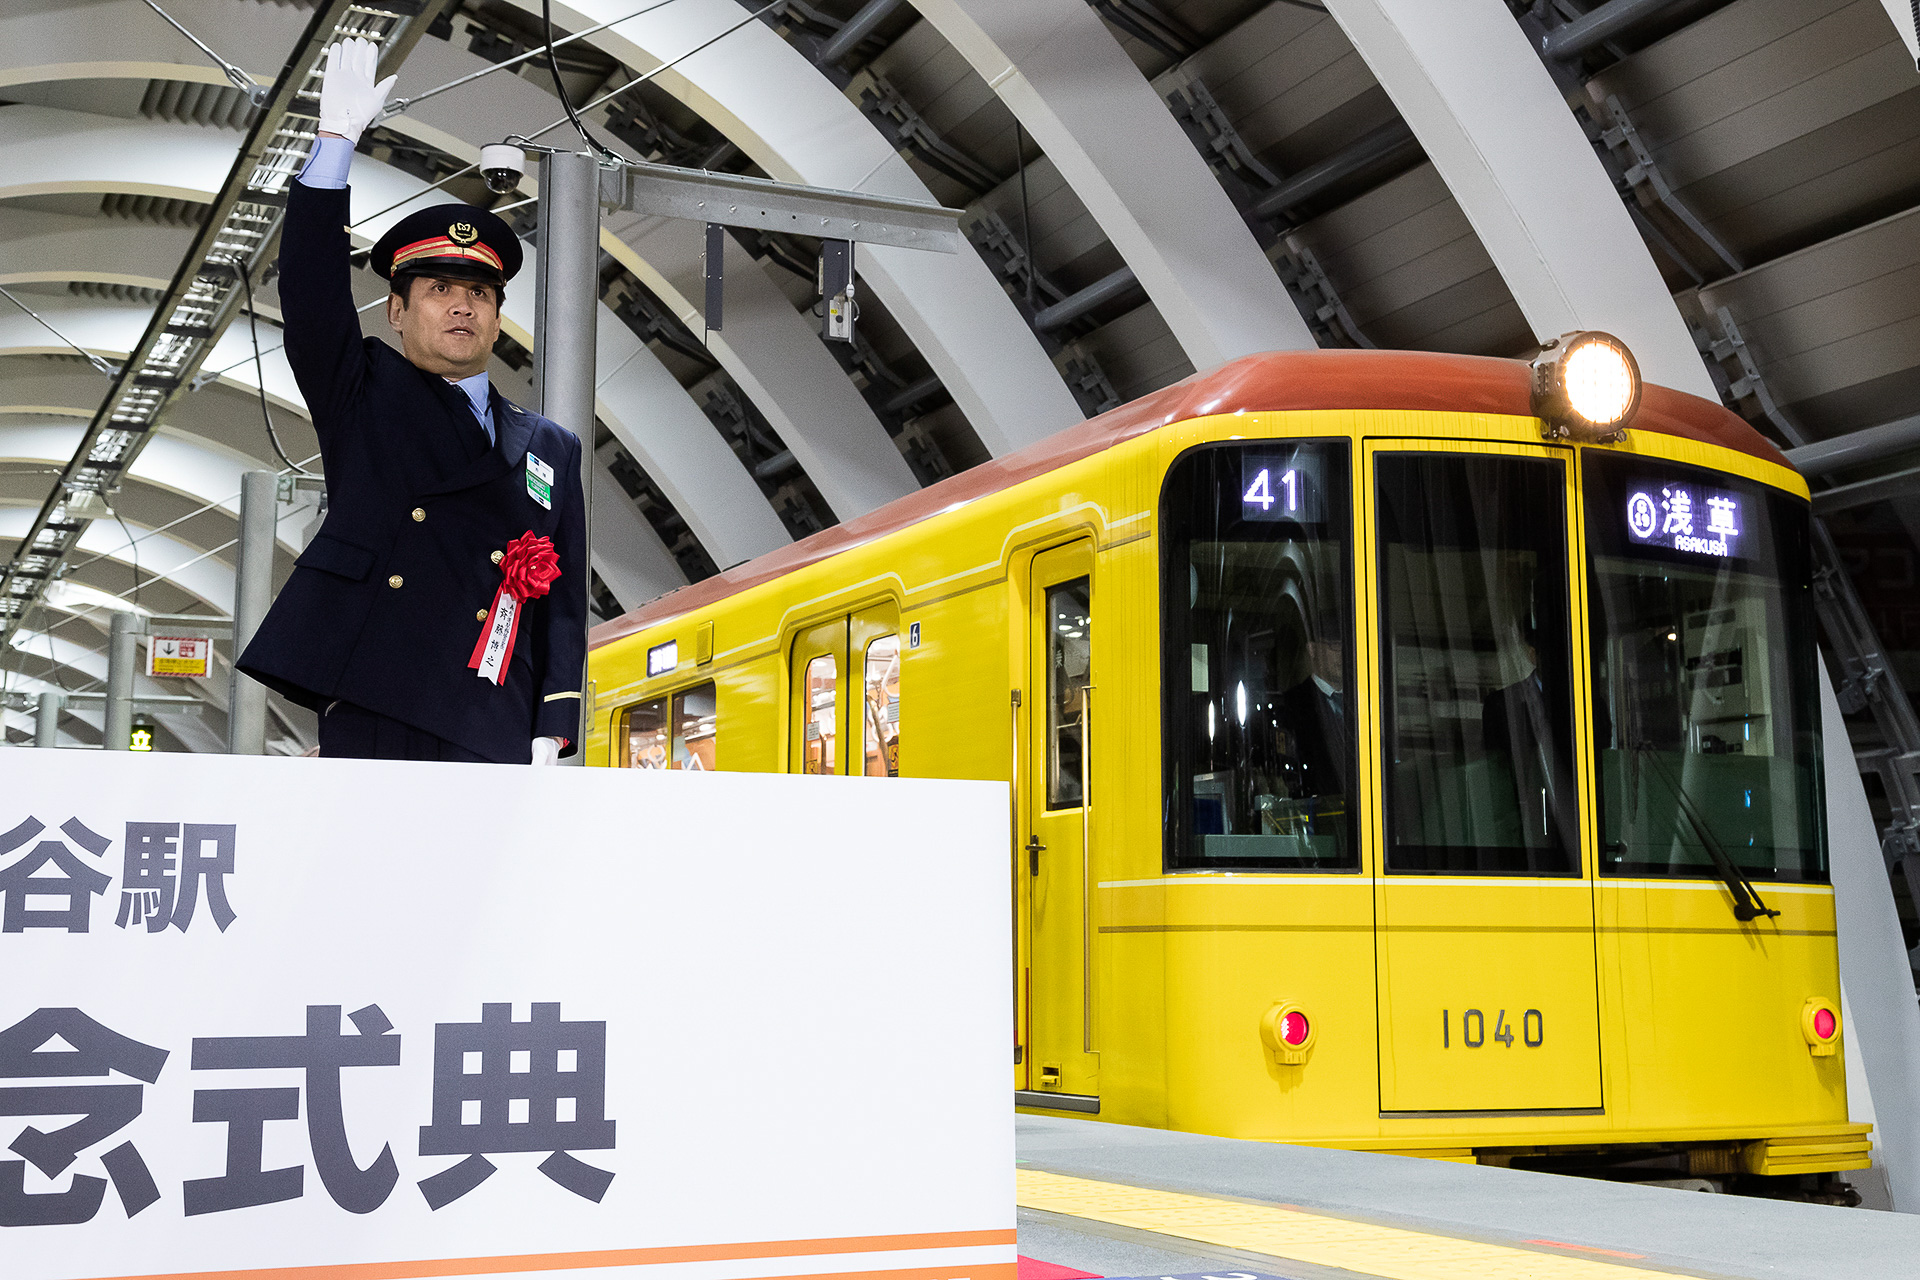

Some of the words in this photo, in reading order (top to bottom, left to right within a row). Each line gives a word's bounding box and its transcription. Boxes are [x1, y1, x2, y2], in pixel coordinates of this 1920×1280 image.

[1243, 468, 1296, 512] 41
[1662, 487, 1739, 542] 浅草
[1674, 534, 1728, 557] ASAKUSA
[911, 624, 919, 647] 6
[0, 815, 238, 934] 谷駅
[1442, 1008, 1544, 1049] 1040
[0, 1001, 617, 1228] 念式典
